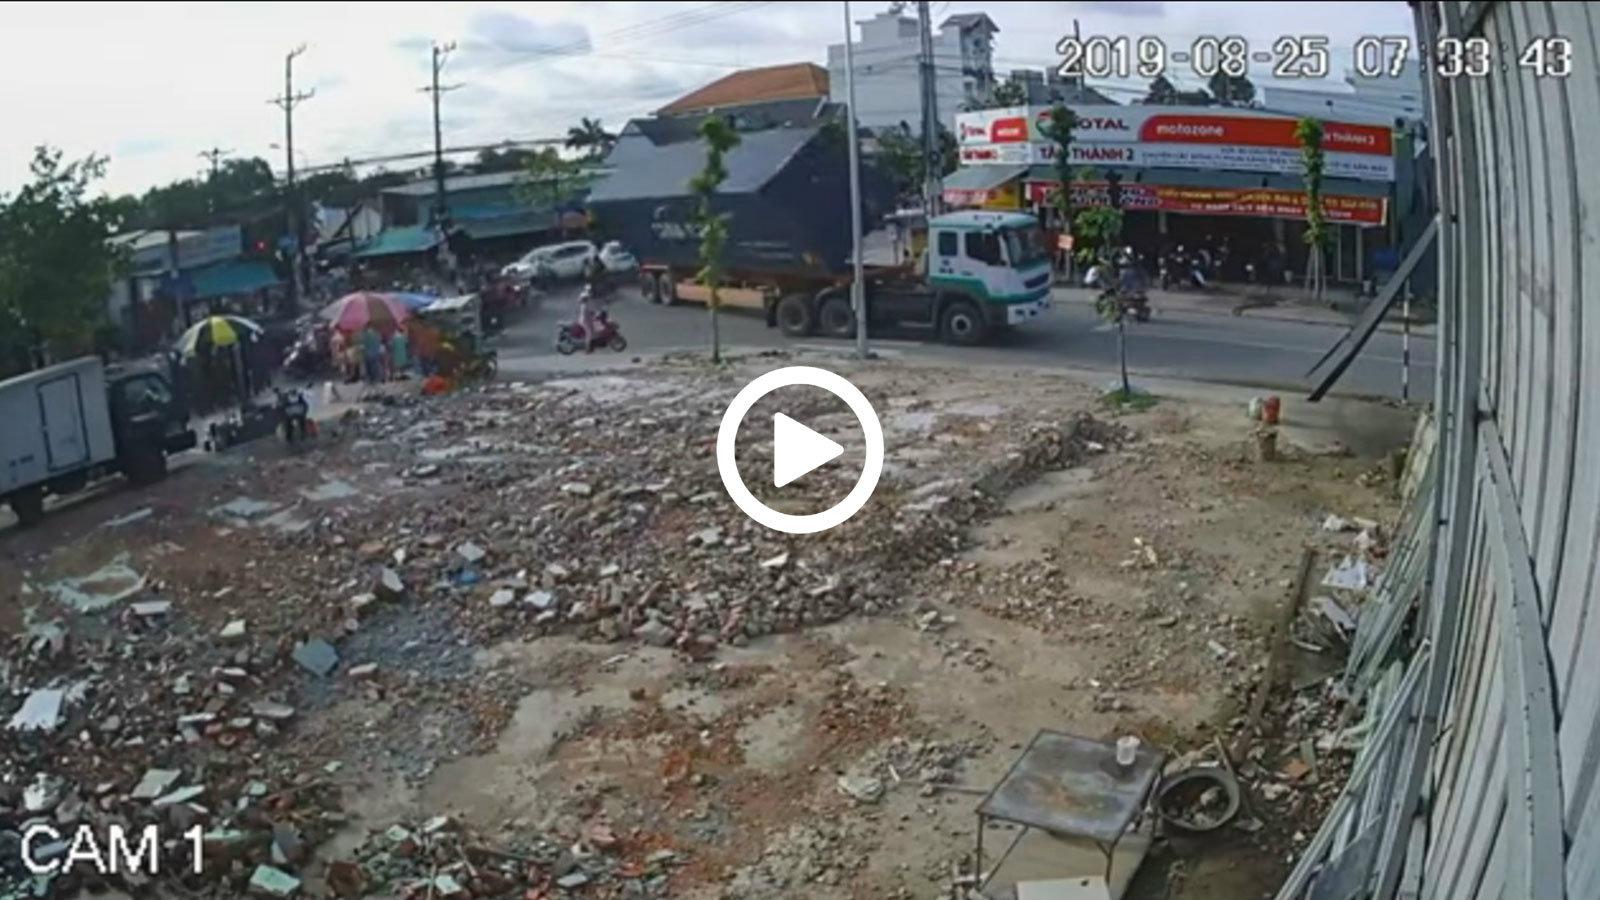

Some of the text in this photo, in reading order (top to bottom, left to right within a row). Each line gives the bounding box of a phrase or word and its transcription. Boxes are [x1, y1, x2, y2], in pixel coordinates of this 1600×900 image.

[1156, 123, 1225, 137] motozone
[1071, 145, 1123, 160] THÀNH
[1126, 147, 1135, 162] 2
